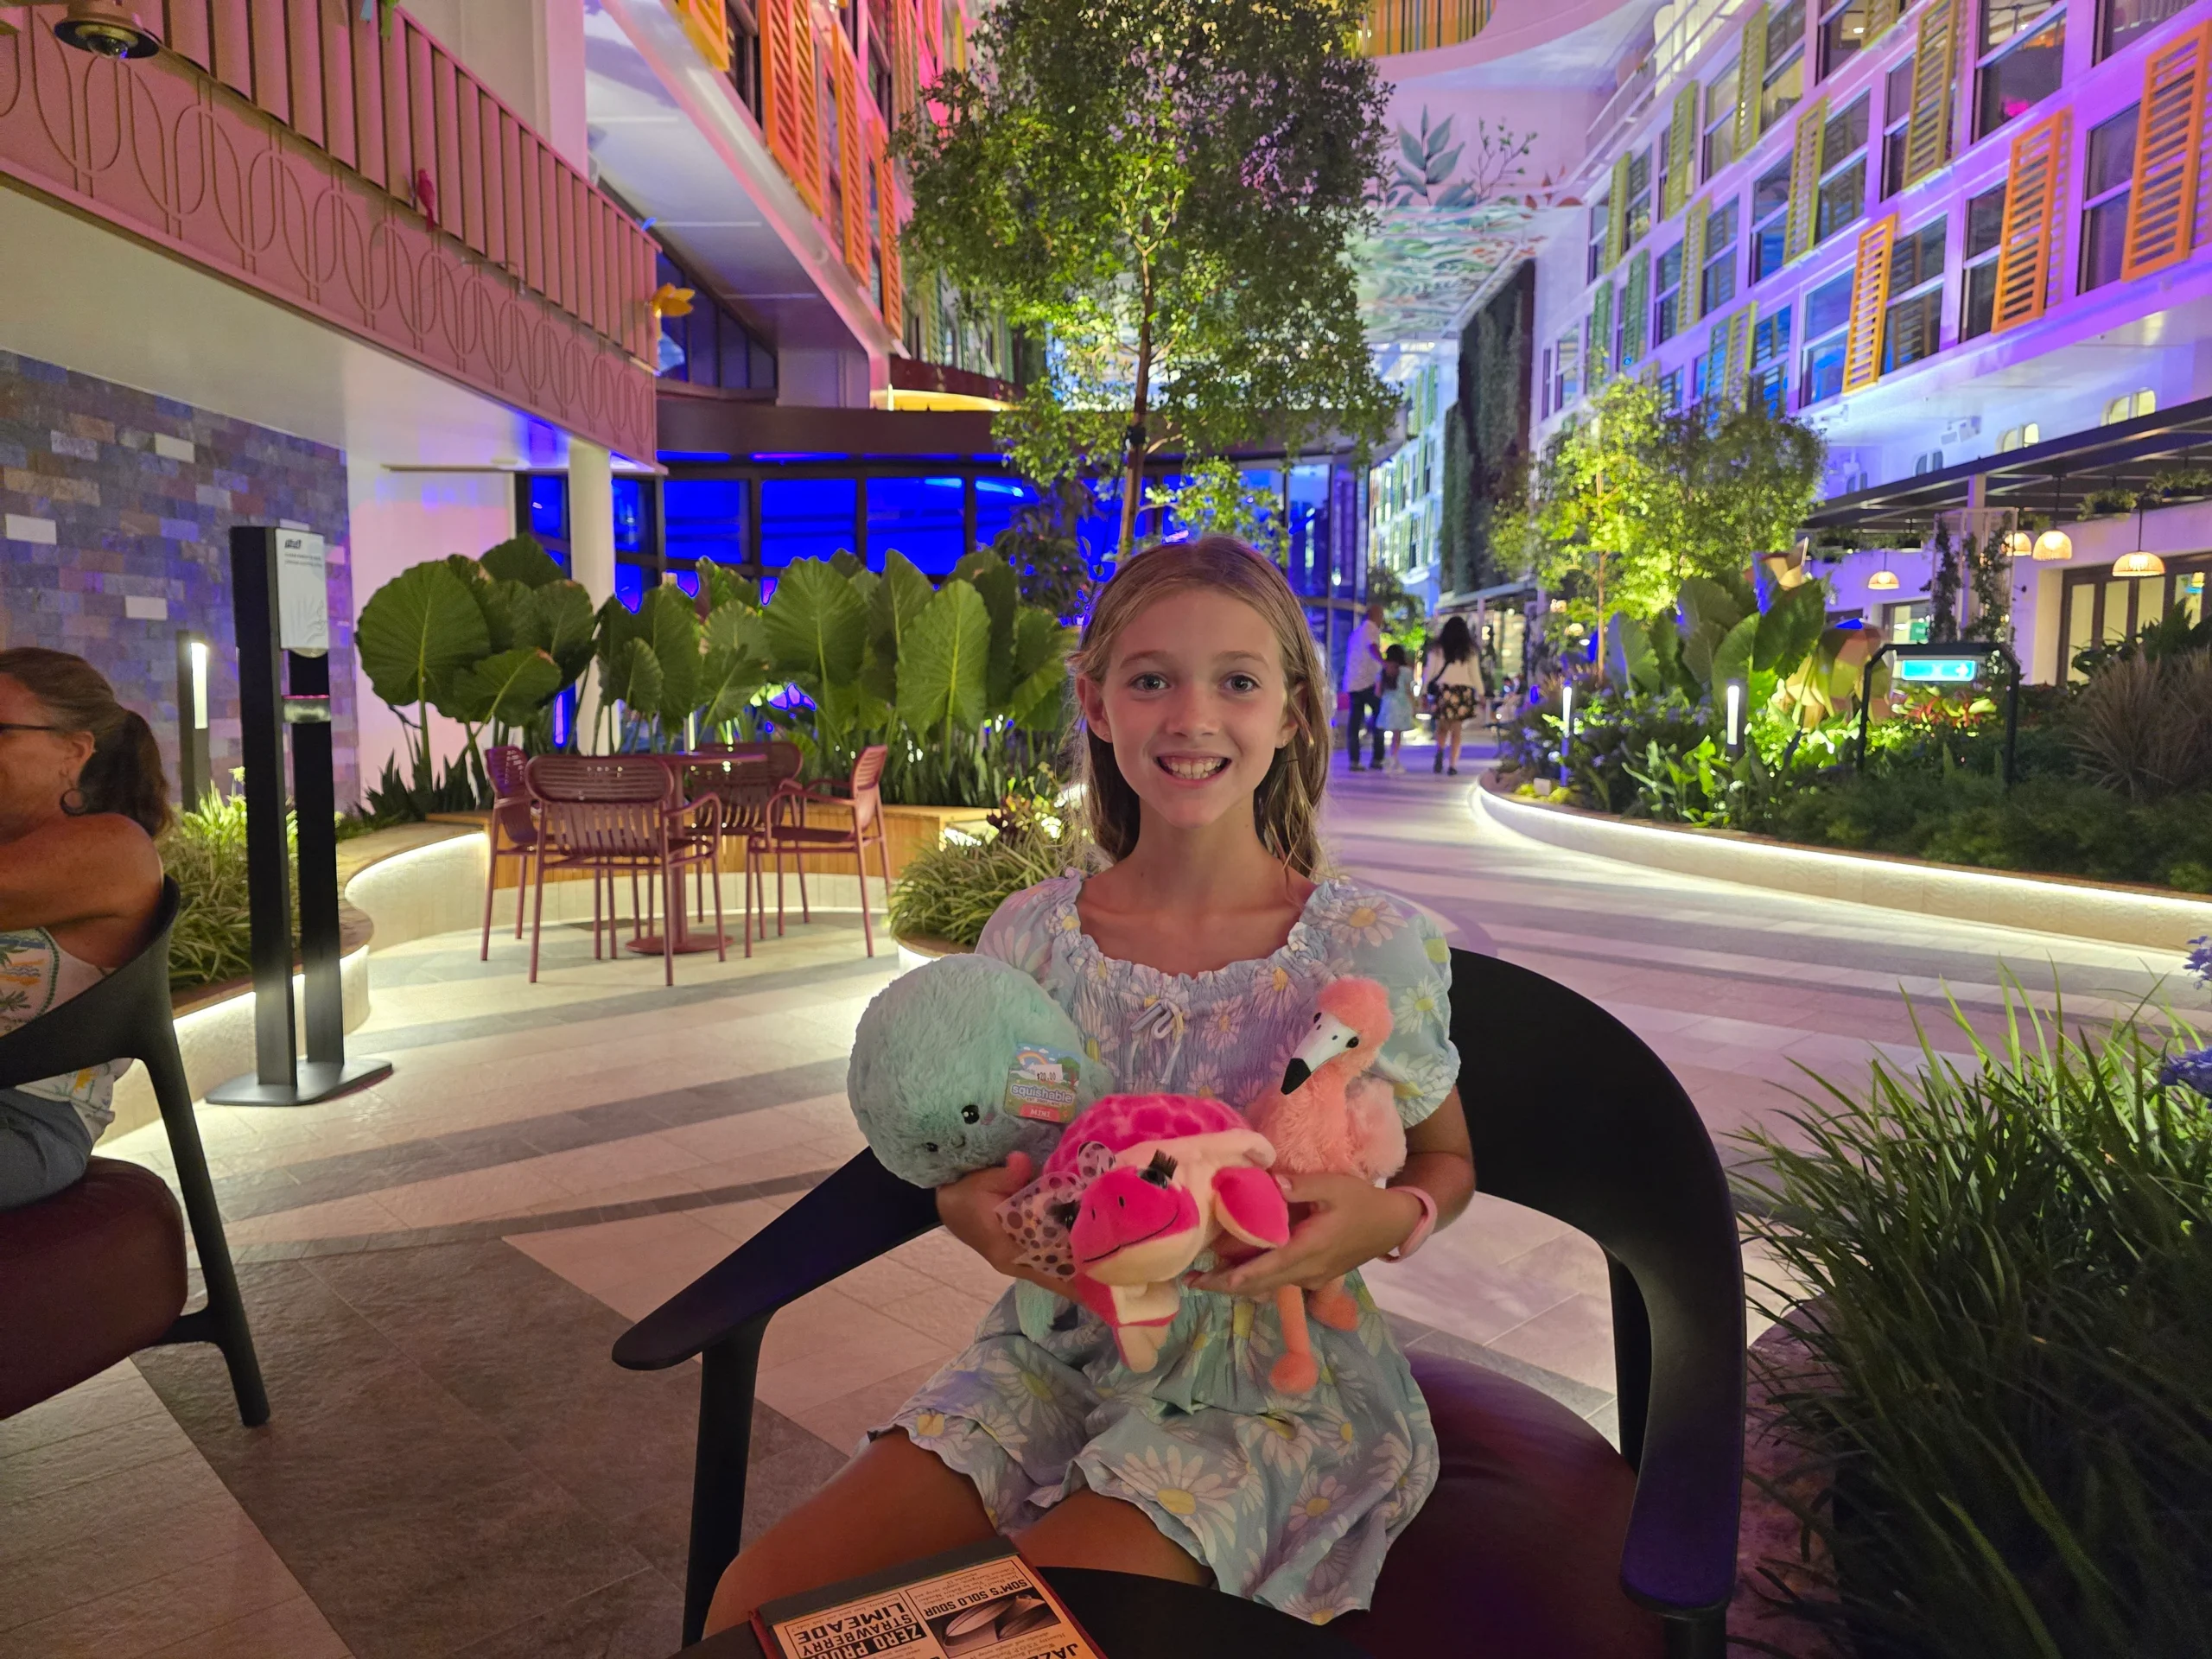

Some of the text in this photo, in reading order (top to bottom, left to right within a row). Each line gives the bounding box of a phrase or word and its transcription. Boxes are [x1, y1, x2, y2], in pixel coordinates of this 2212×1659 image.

[1036, 1071, 1057, 1082] $20.00
[1011, 1084, 1072, 1104] squishable
[1029, 1109, 1052, 1117] MINI
[925, 1579, 1027, 1617] SOM'S SOLO SOUR
[794, 1602, 905, 1644] LIMEADE
[800, 1613, 912, 1656] STRAWBERRY
[873, 1624, 922, 1649] ZERO
